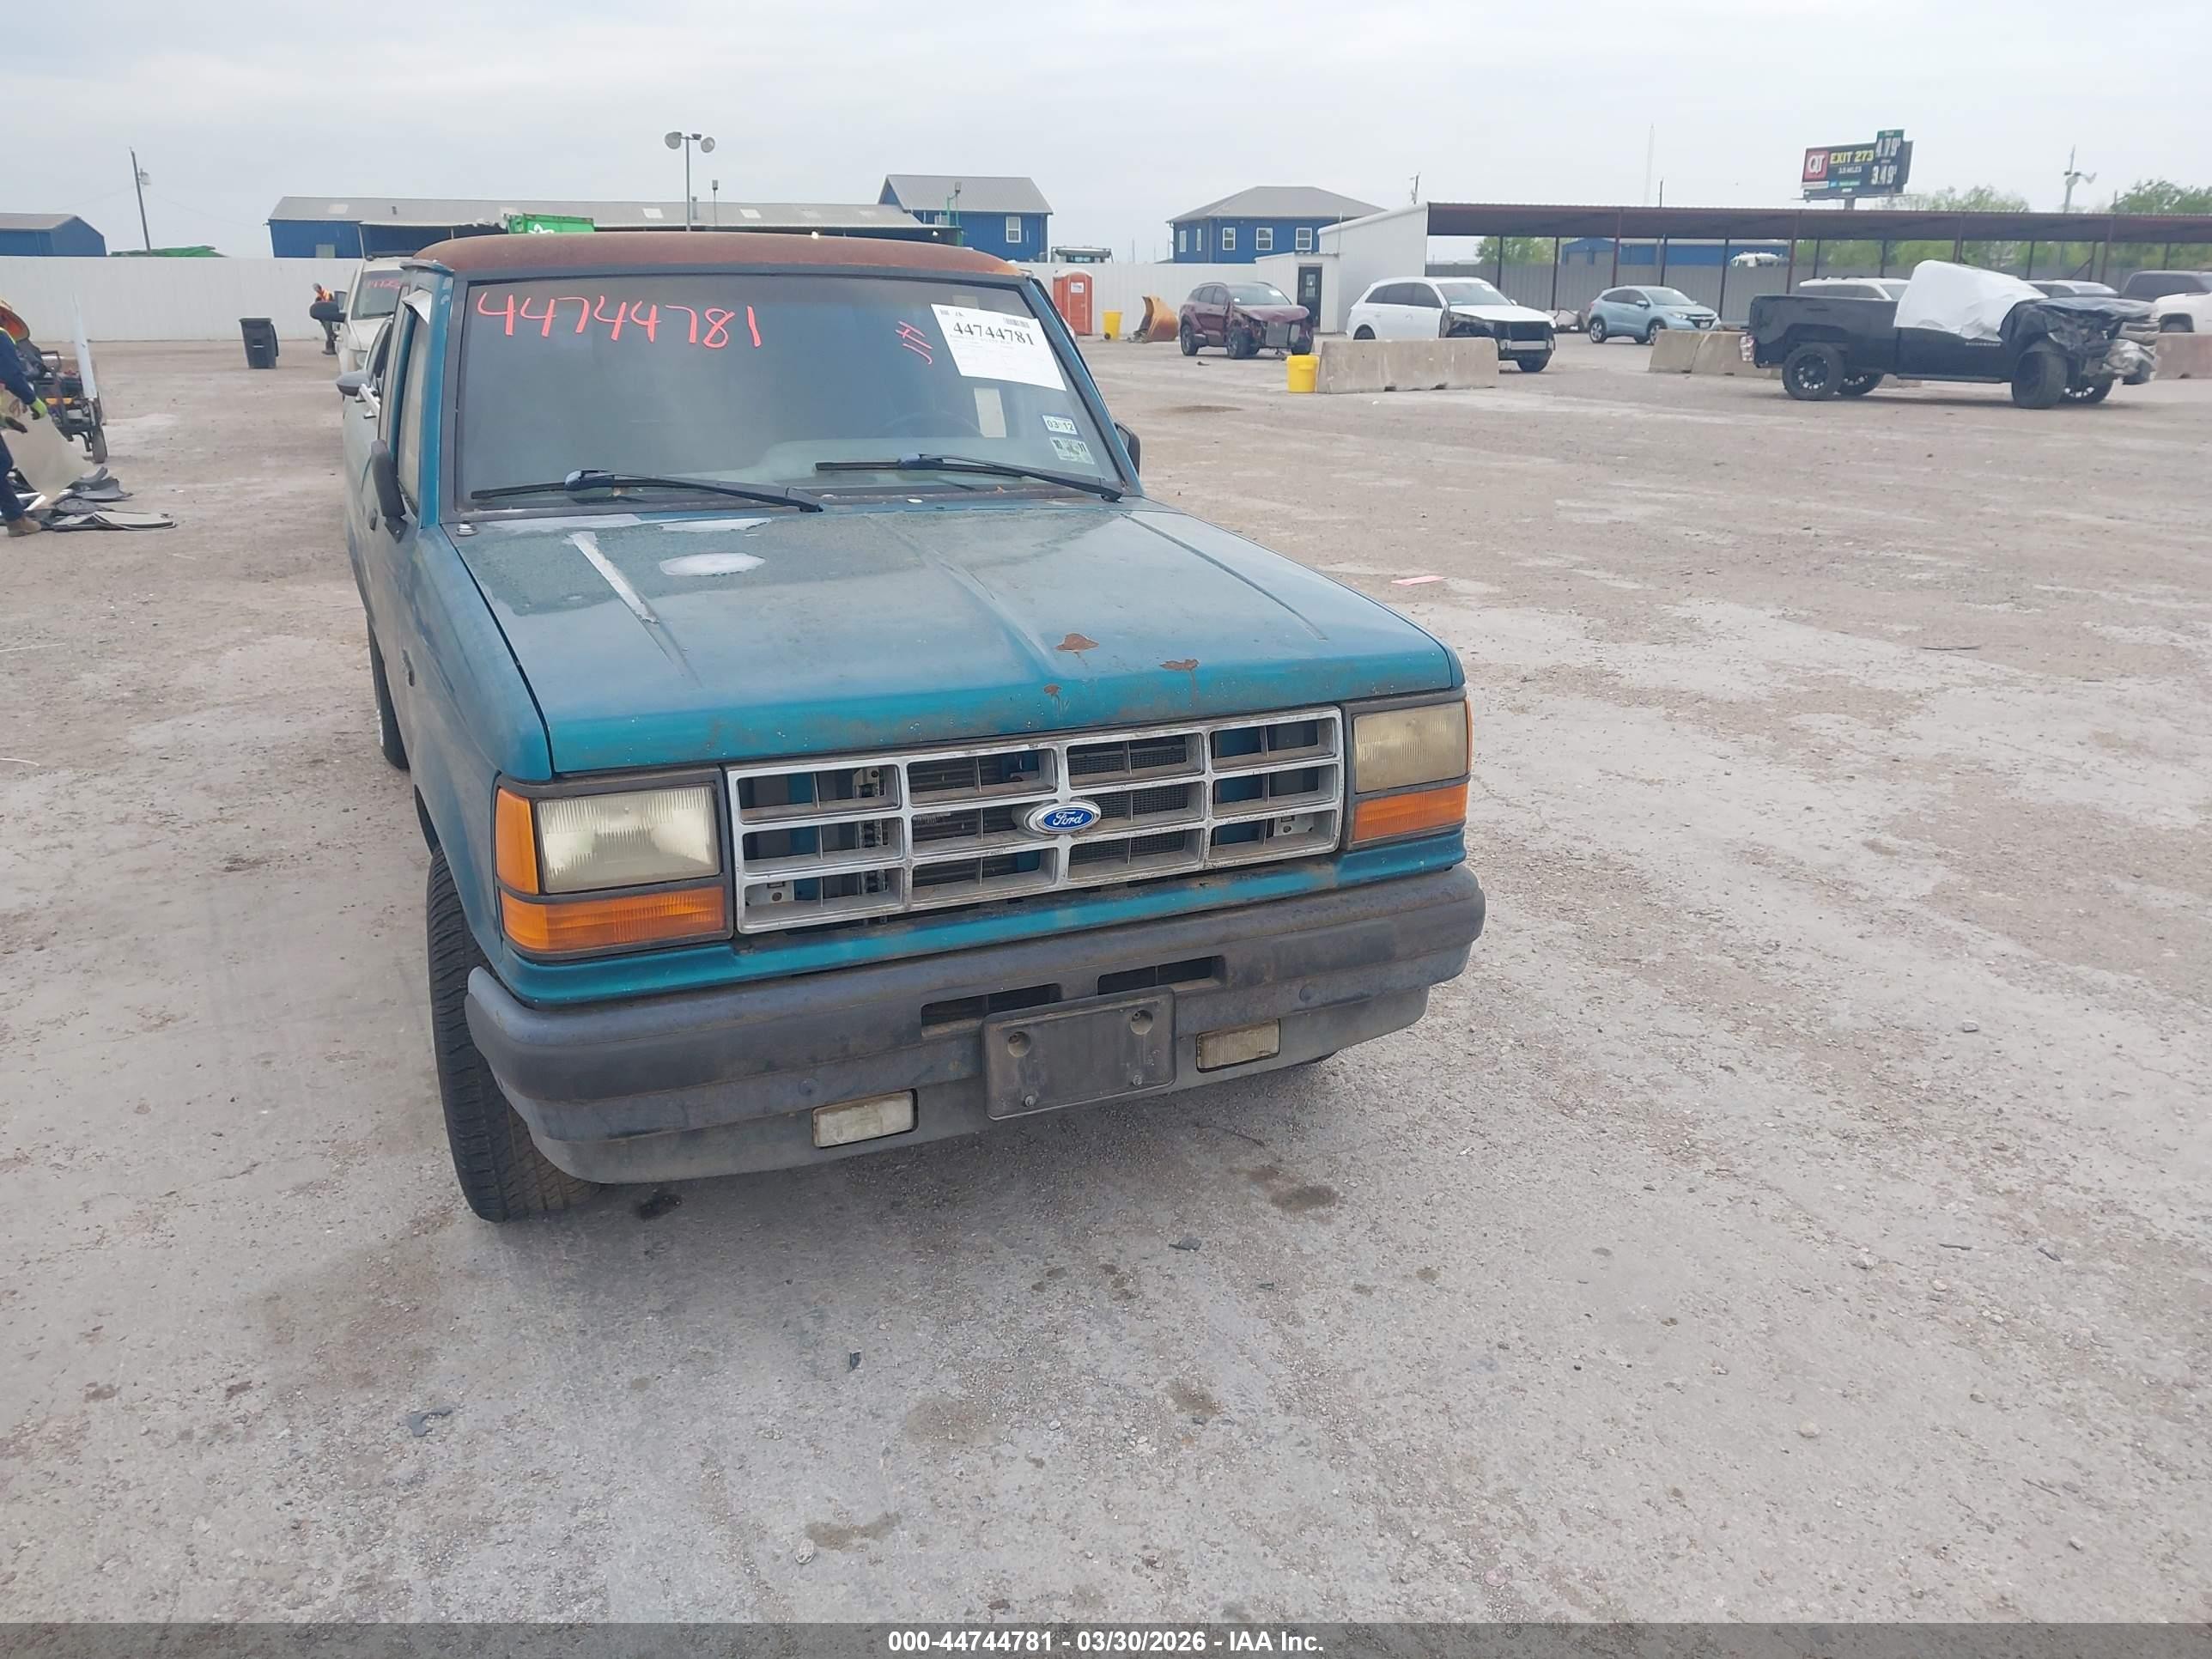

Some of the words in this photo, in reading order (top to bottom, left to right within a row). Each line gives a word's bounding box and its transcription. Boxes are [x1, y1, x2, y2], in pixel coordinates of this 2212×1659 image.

[1808, 155, 1825, 173] QT
[1830, 151, 1853, 164] EXIT
[1854, 149, 1875, 162] 273
[477, 292, 762, 348] 44744781
[953, 322, 1034, 345] 44744781
[1047, 420, 1060, 428] 03
[1063, 422, 1074, 431] 12
[1053, 811, 1084, 826] Ford
